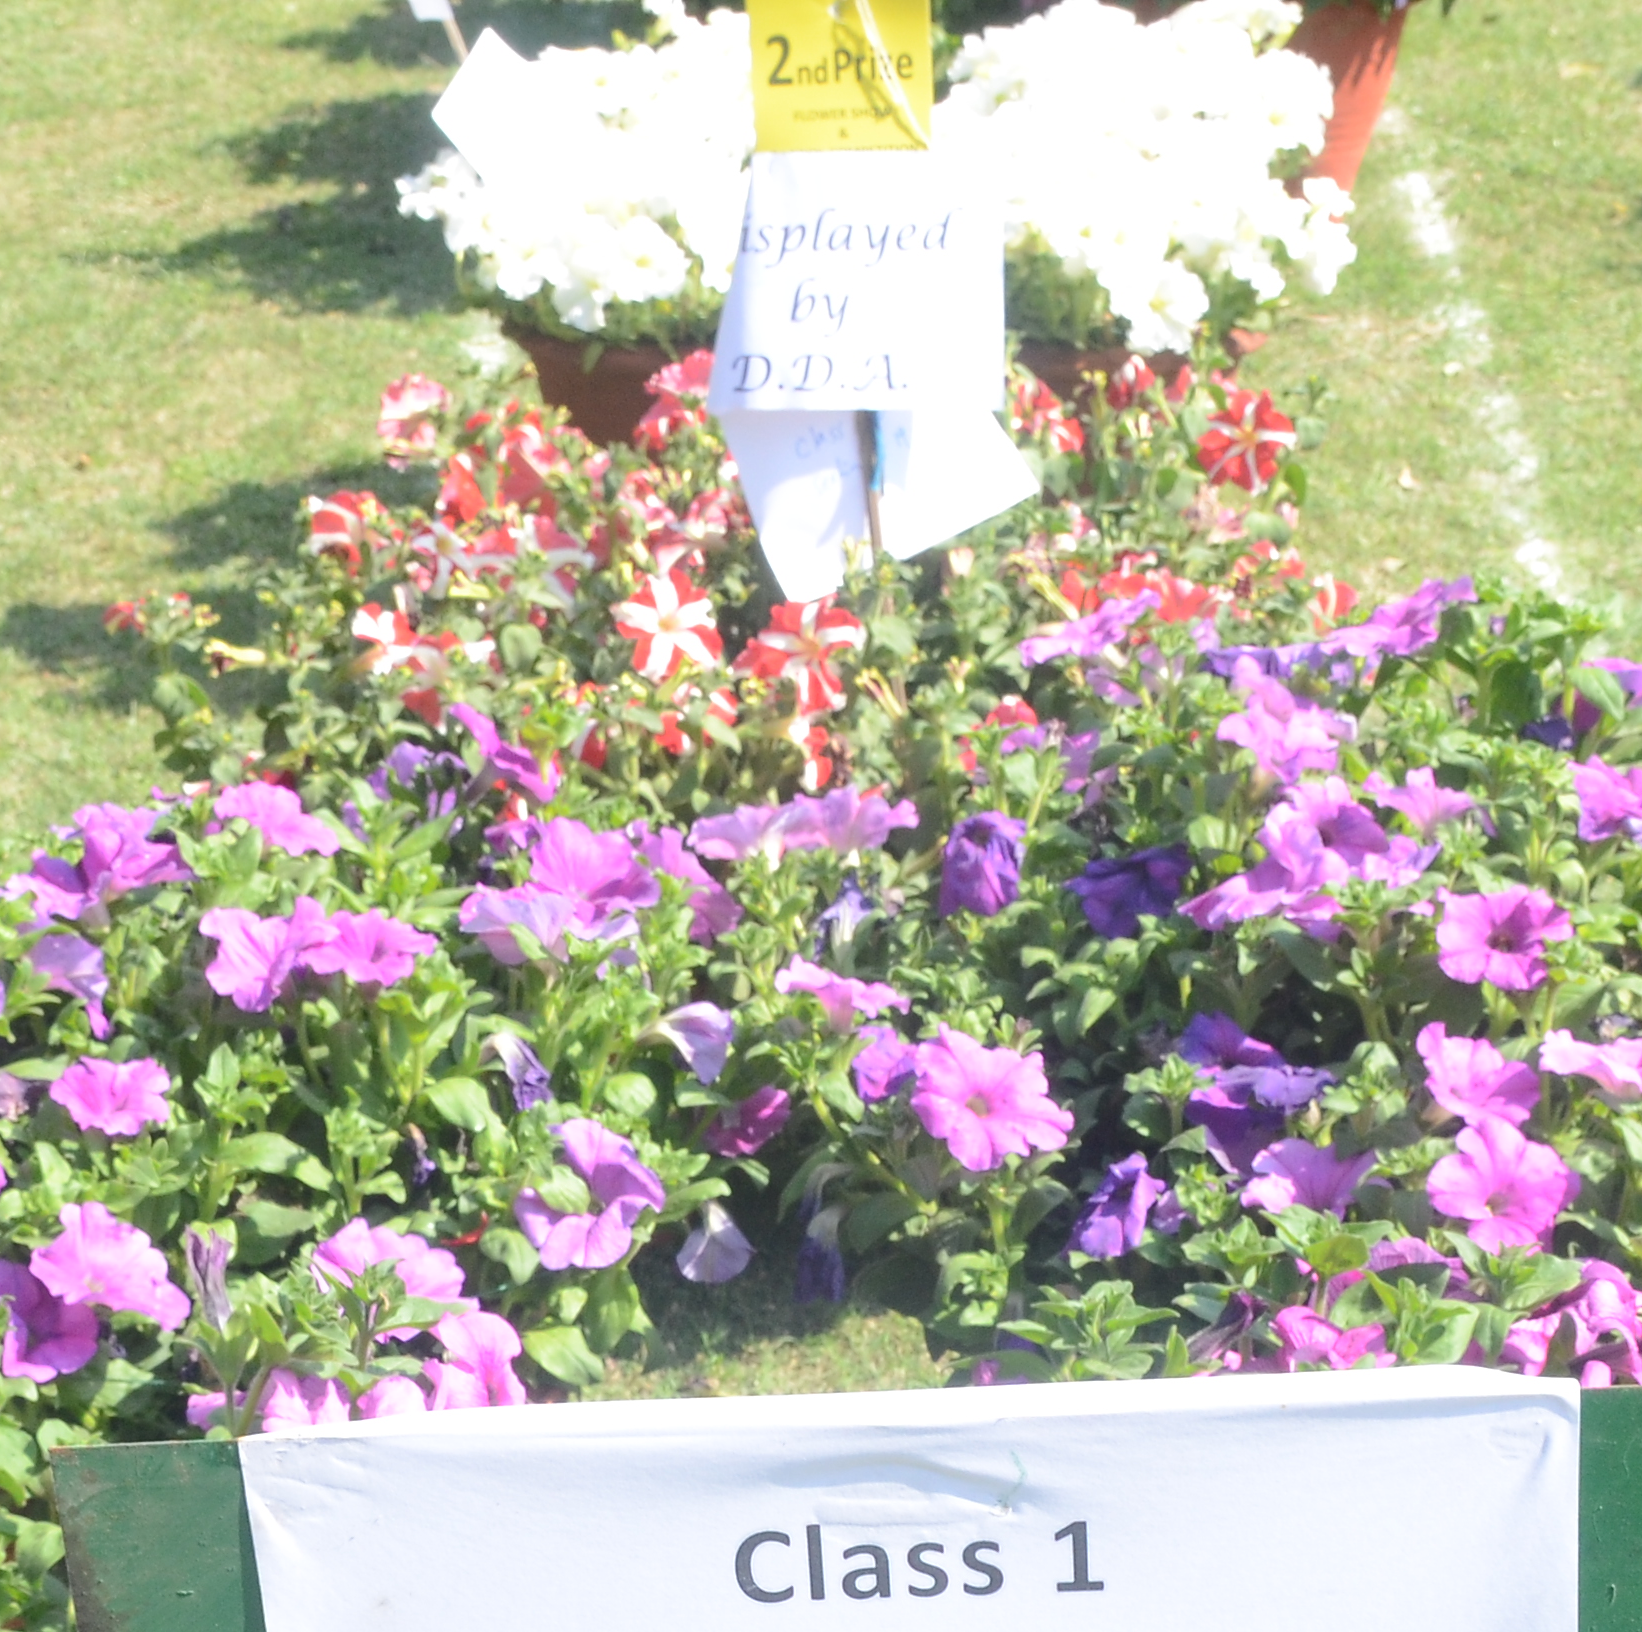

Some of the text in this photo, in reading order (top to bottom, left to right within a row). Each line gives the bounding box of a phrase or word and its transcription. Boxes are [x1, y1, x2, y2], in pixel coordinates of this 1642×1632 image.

[741, 207, 961, 268] isplayed
[790, 277, 849, 337] by
[731, 354, 907, 392] D.D.A.
[734, 1521, 1105, 1603] Class 1
